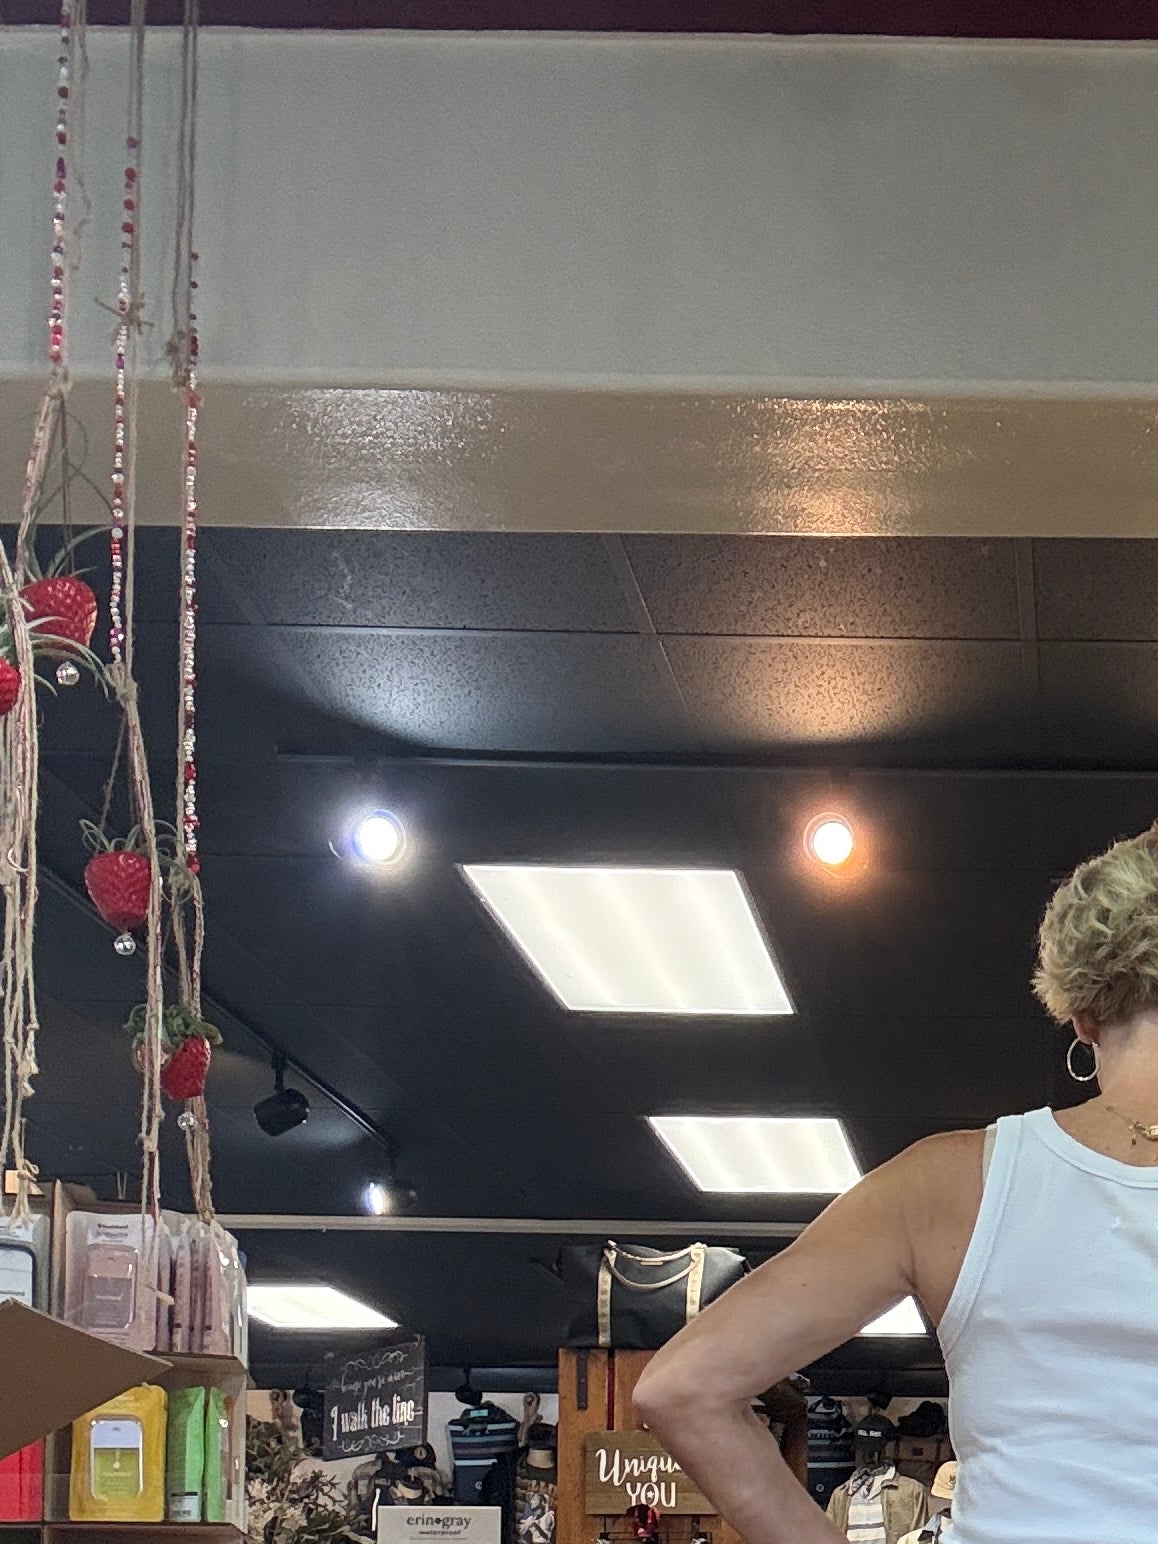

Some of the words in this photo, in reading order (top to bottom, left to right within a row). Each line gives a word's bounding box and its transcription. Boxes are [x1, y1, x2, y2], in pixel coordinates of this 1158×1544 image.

[330, 1405, 339, 1441] I
[341, 1400, 368, 1433] walk
[371, 1396, 390, 1428] the
[392, 1393, 417, 1426] line
[625, 1482, 676, 1508] YOU
